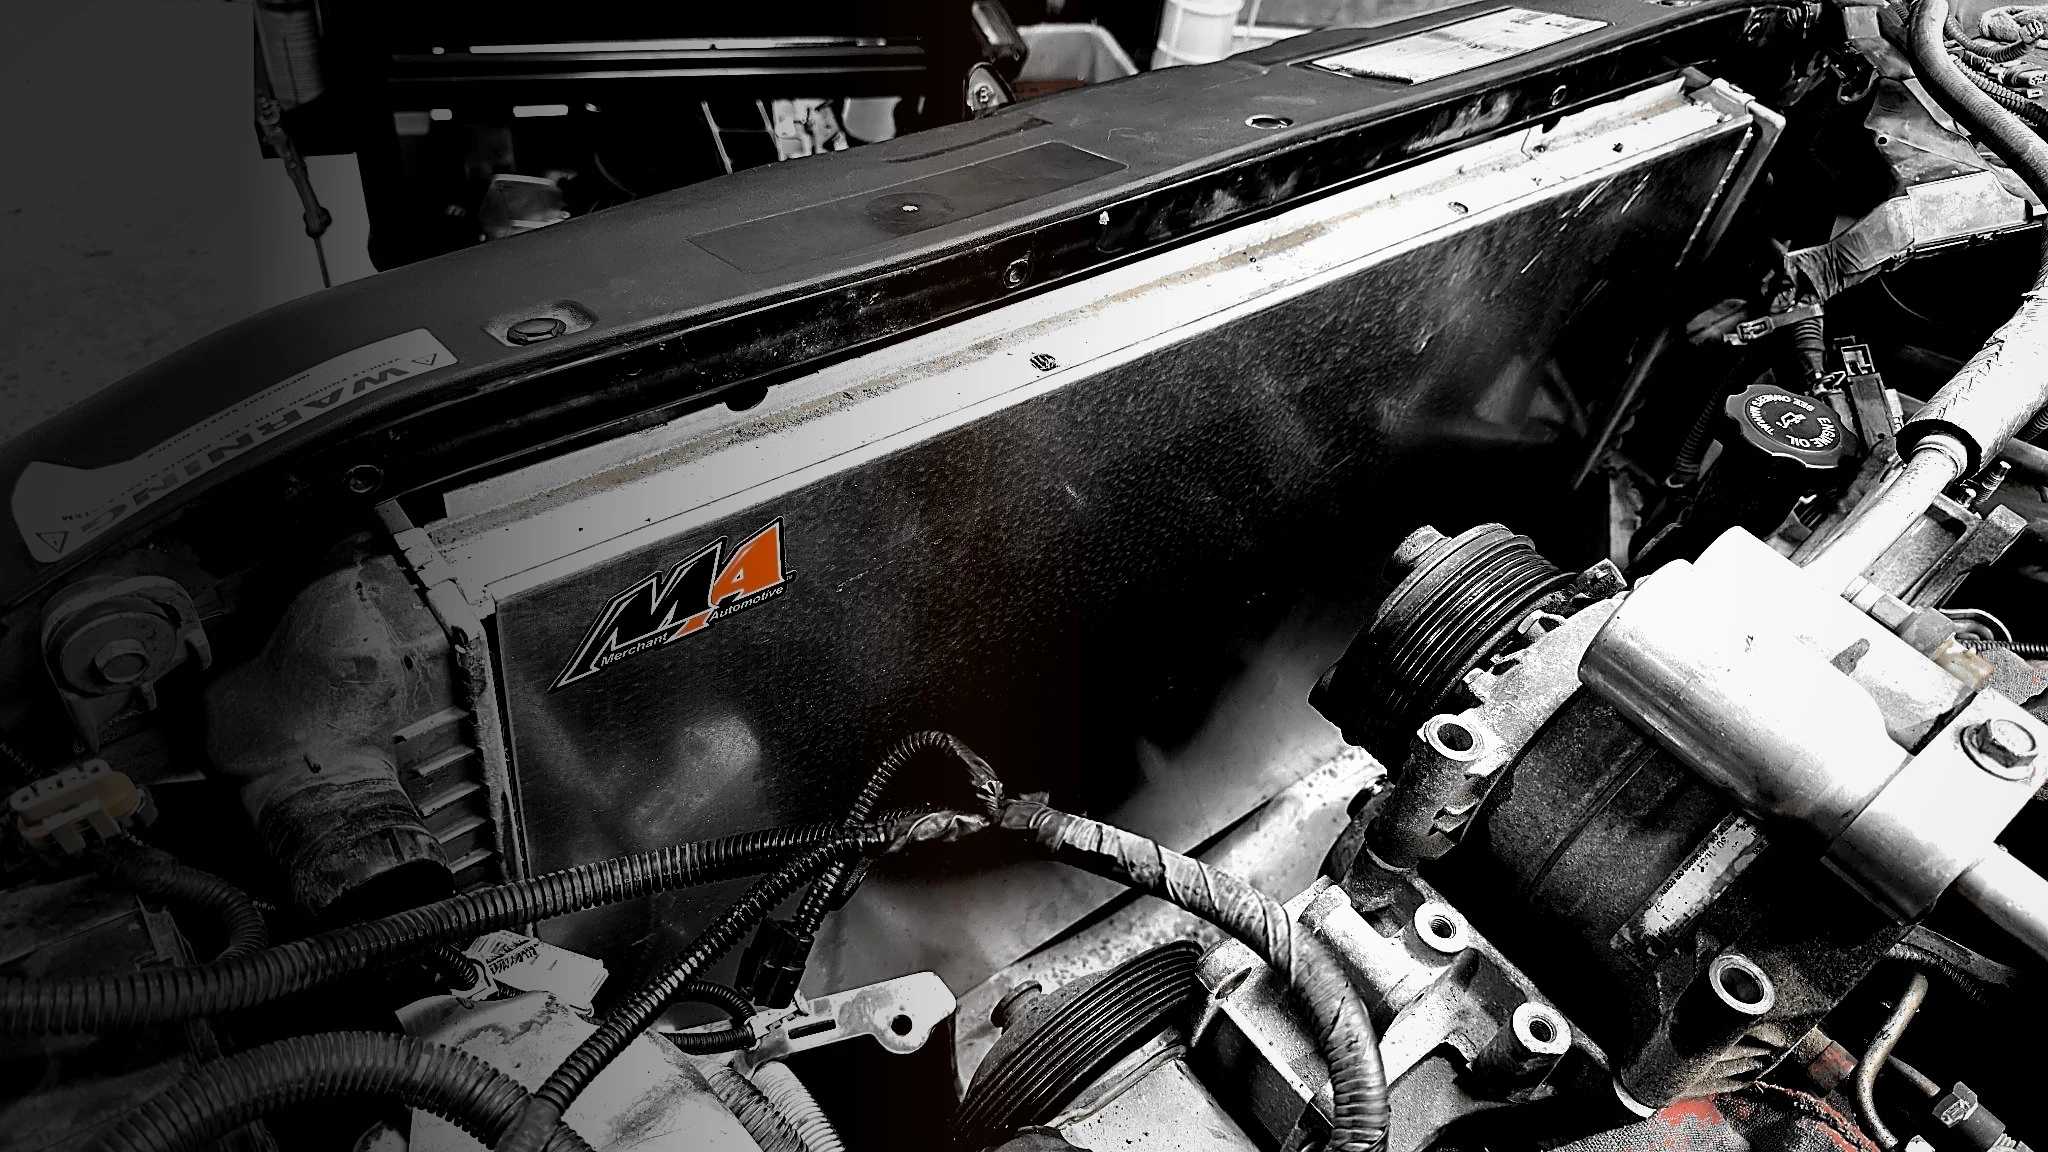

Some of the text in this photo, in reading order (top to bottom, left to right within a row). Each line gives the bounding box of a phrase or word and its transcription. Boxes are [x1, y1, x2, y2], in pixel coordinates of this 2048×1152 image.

[244, 373, 311, 407] IMPORTANT
[194, 408, 239, 432] SAFETY
[1785, 417, 1836, 448] ENGINE OIL
[81, 368, 410, 534] WARNING
[600, 584, 785, 667] Merchant Automotive
[1674, 869, 1685, 880] OR
